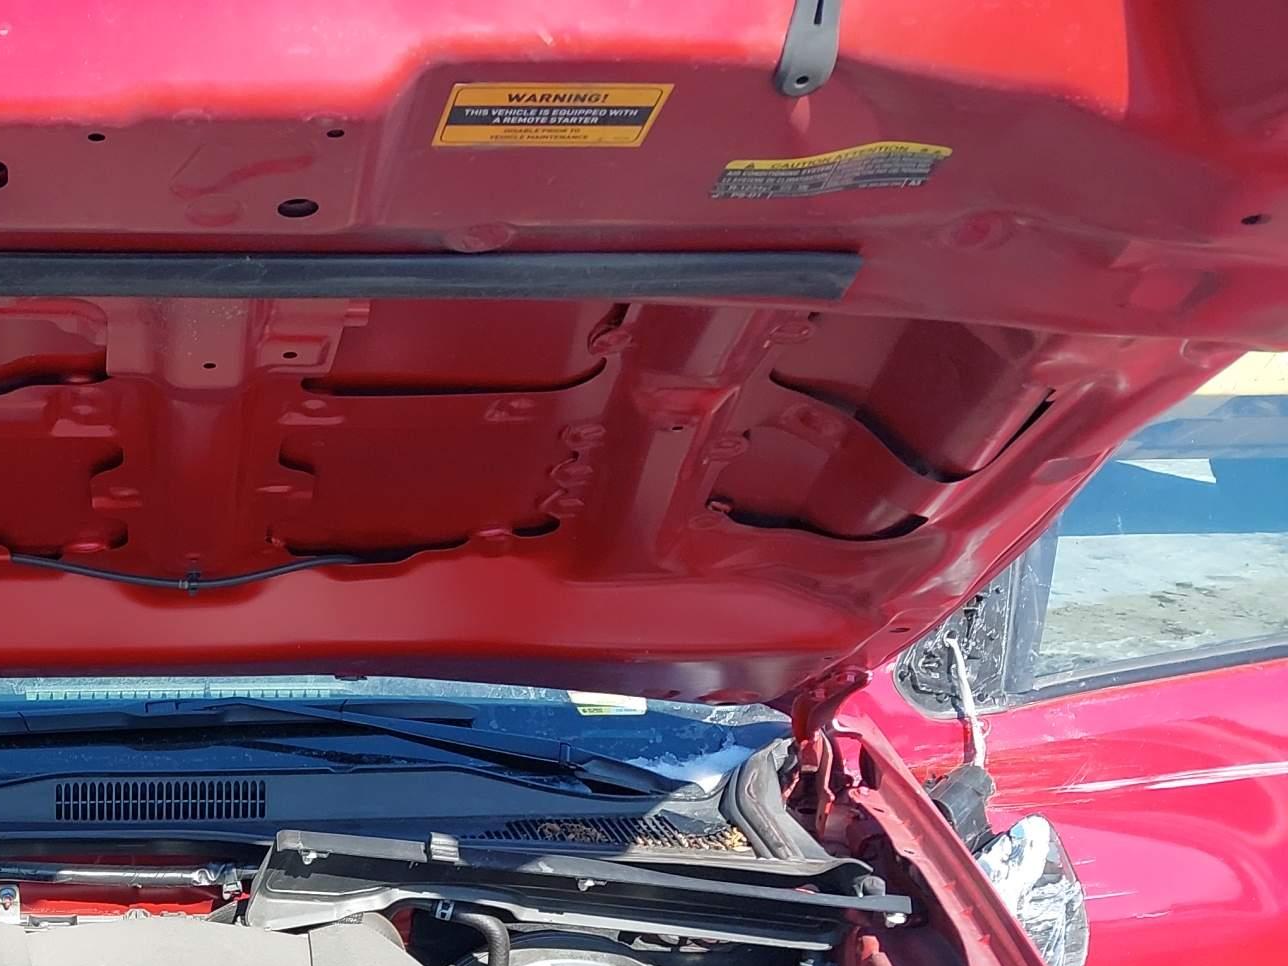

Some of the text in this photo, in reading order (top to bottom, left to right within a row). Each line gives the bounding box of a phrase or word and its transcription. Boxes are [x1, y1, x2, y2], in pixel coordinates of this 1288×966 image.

[507, 93, 609, 103] WARNING!
[464, 108, 639, 117] THIS VEHICLE IS EQUIPPED WITH
[492, 116, 599, 125] A REMOTE STARTER
